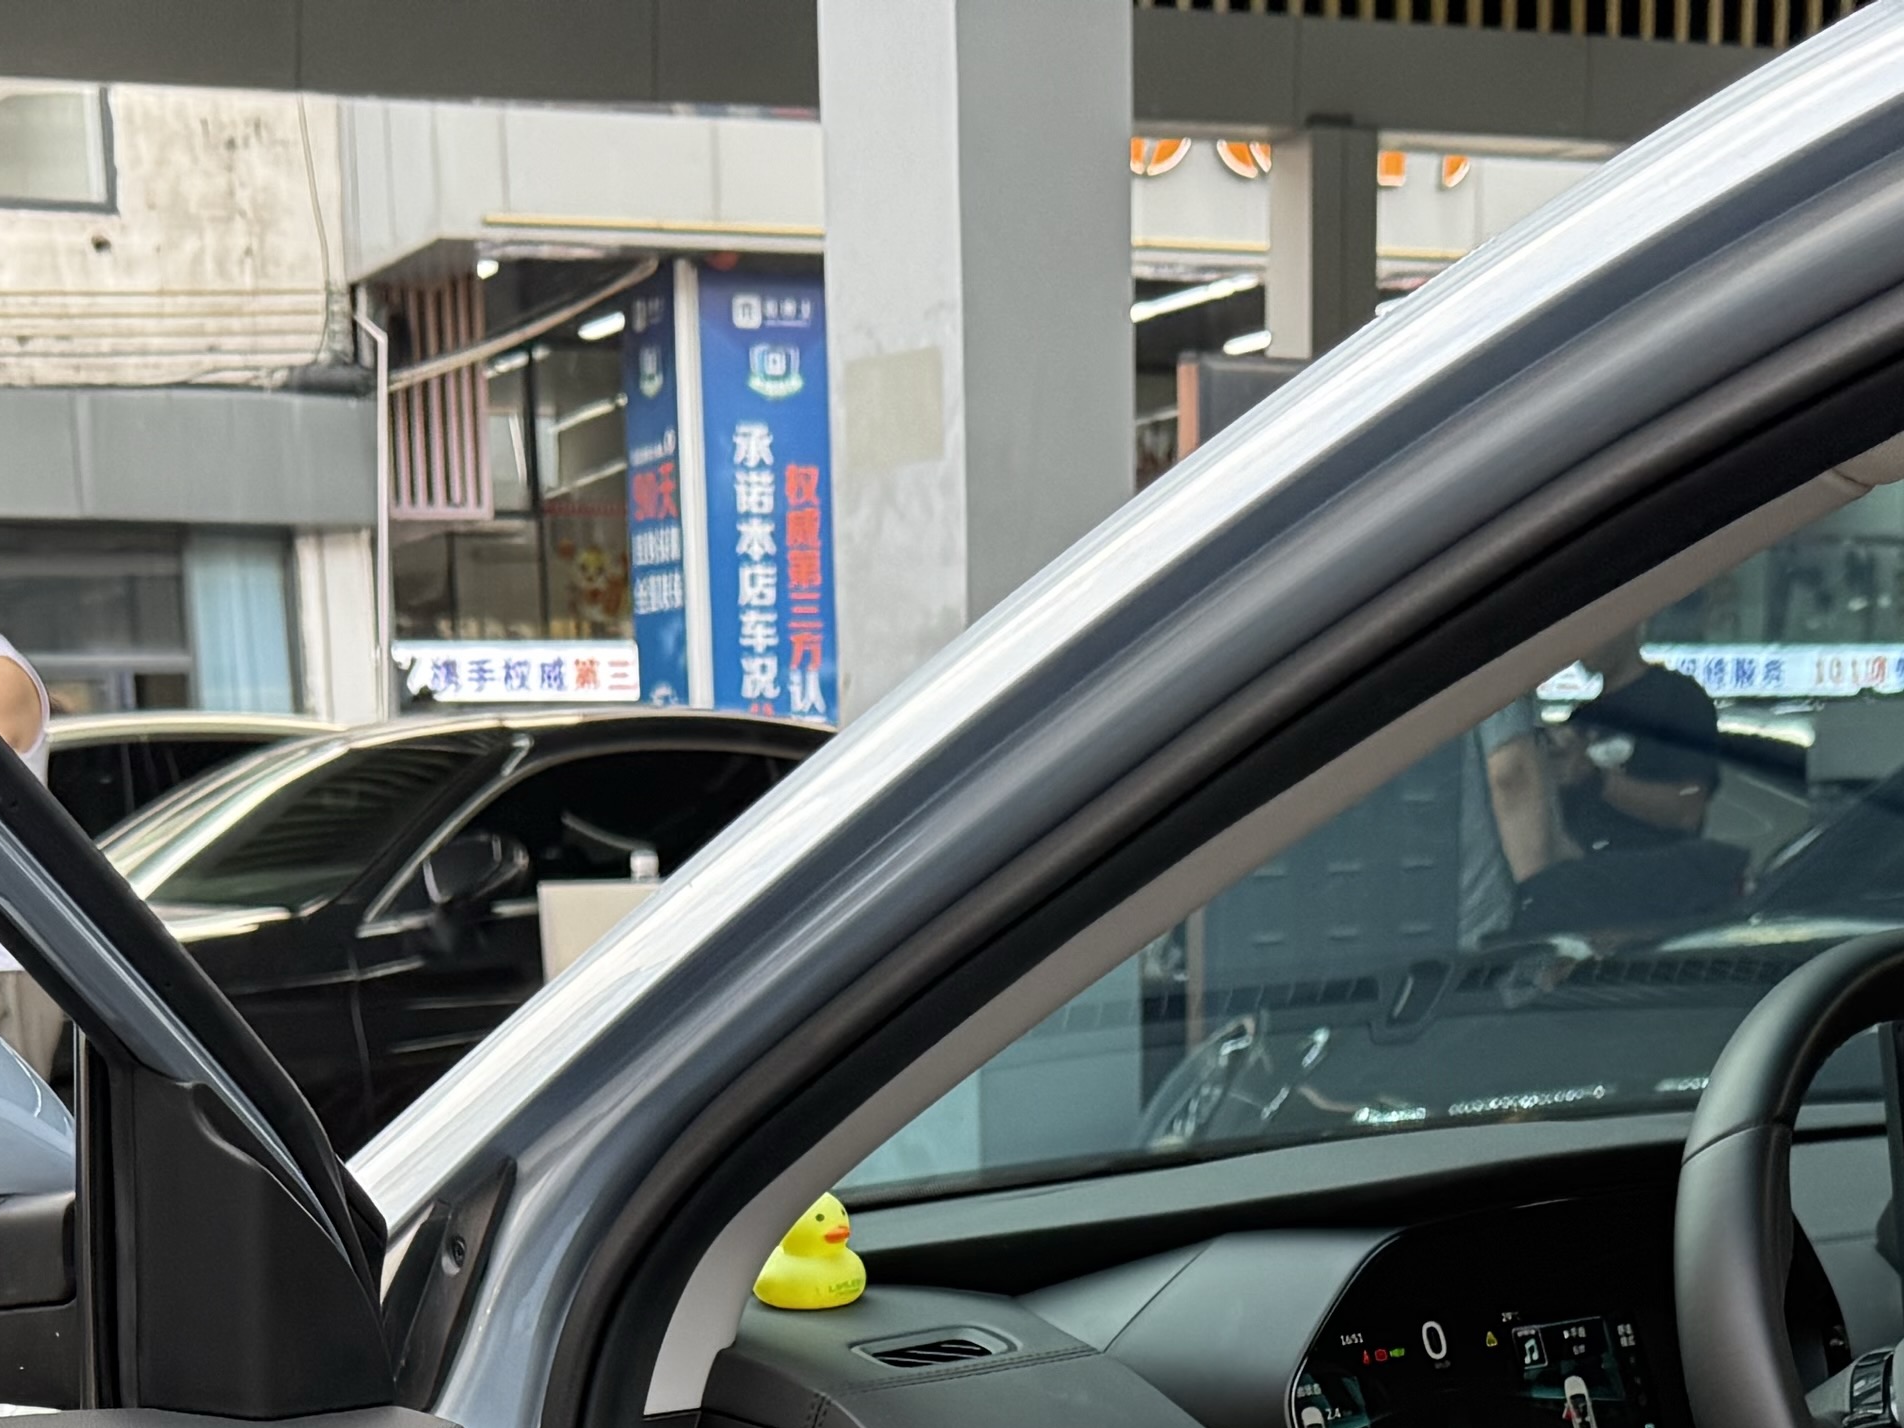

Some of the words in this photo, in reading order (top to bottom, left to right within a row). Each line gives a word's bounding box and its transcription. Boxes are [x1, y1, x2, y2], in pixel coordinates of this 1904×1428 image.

[732, 421, 781, 716] 承诺本店车况
[785, 464, 827, 722] 权威第三方认
[1422, 1321, 1447, 1360] 0
